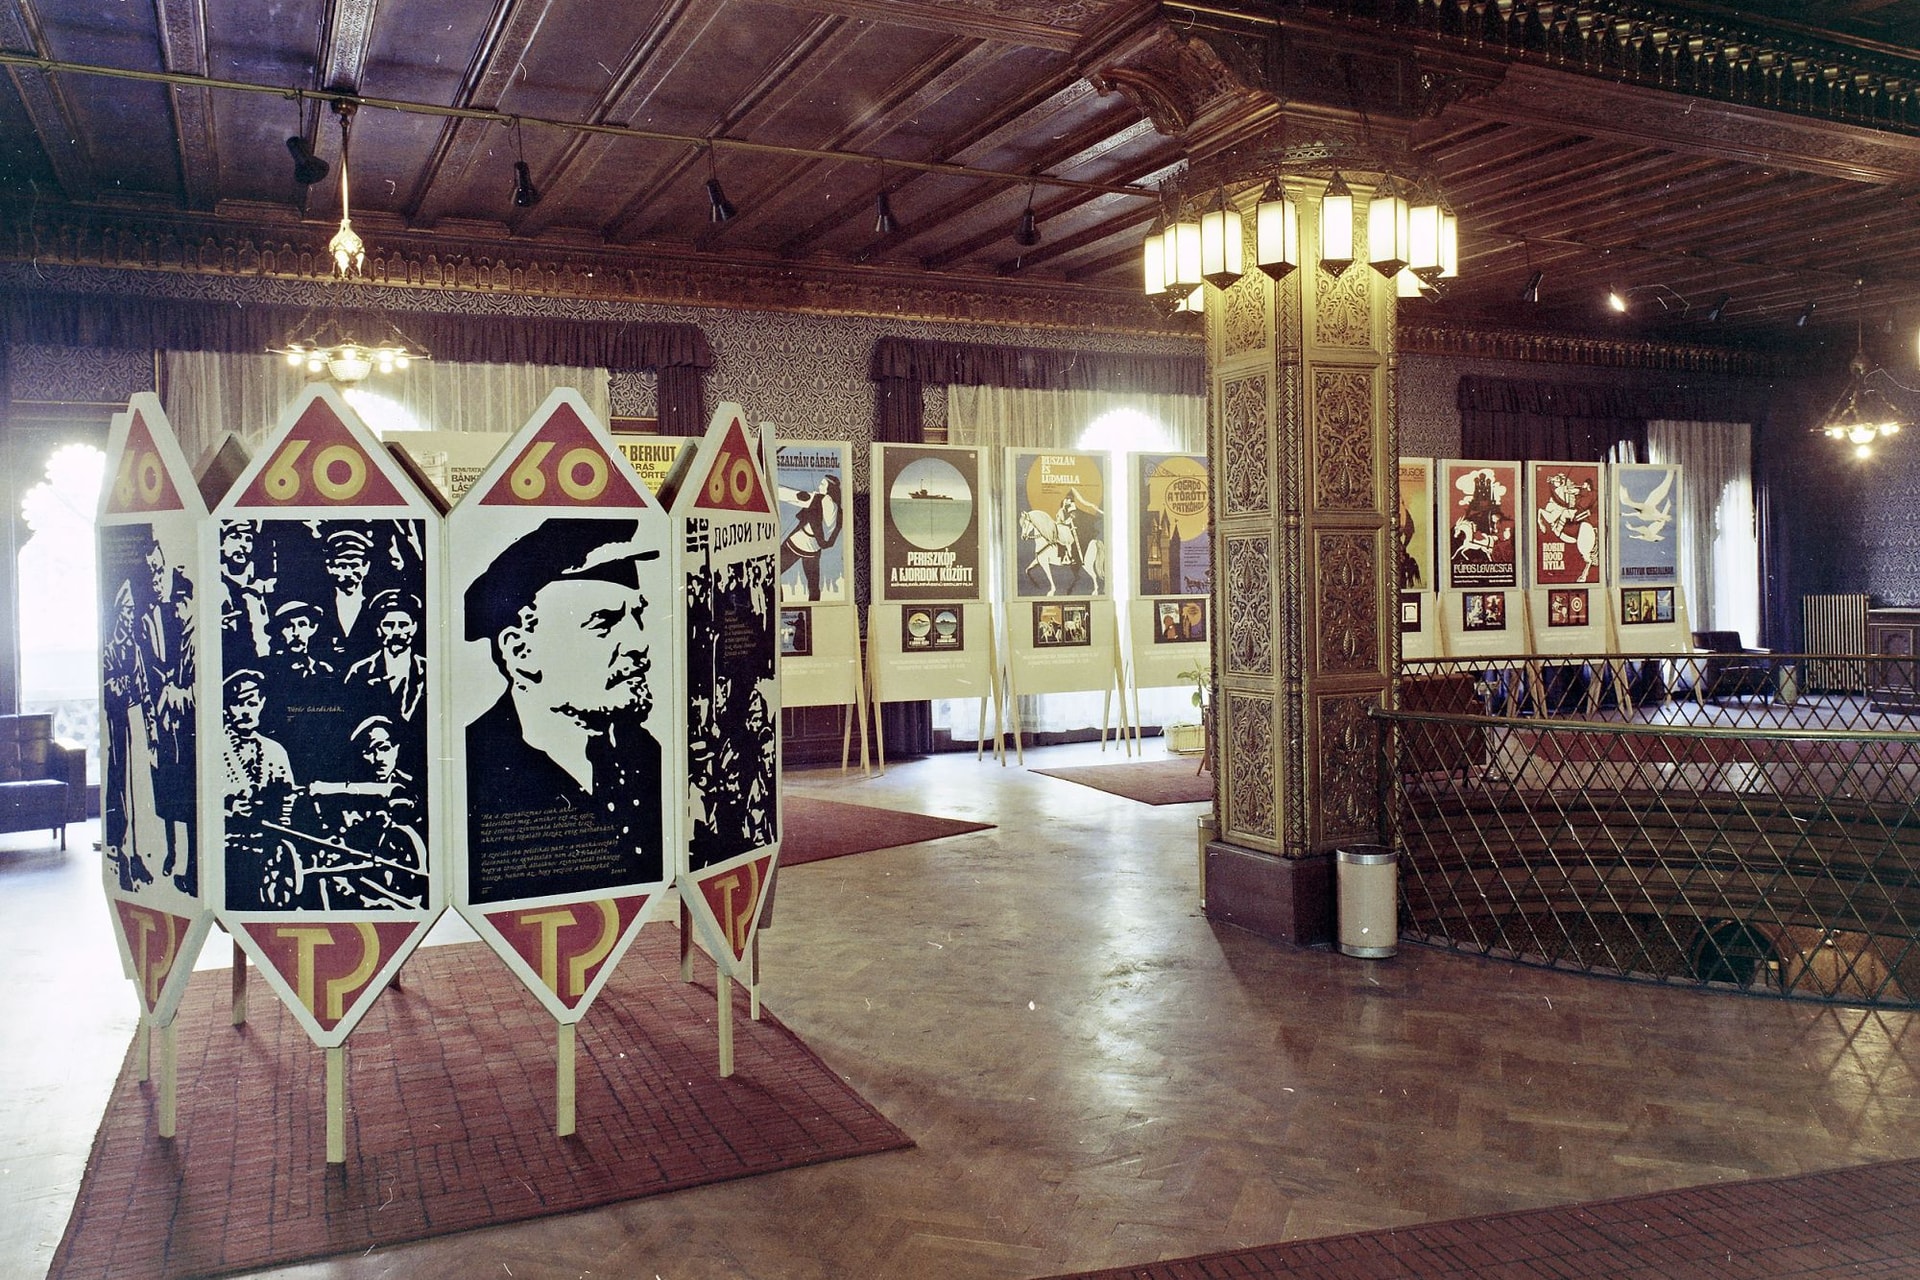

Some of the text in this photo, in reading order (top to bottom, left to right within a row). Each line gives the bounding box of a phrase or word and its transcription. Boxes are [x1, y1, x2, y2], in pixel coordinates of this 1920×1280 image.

[630, 446, 676, 462] BERKUT
[810, 452, 840, 468] CÁRRÓL
[264, 440, 367, 501] 60
[510, 441, 609, 501] 60
[709, 451, 755, 506] 60
[117, 450, 163, 508] 60
[1041, 474, 1080, 484] LUDMILLA
[1173, 480, 1202, 491] FOGADÓ
[1167, 490, 1206, 502] A TÖRÖTT
[907, 548, 956, 566] PERISZKÓP
[1542, 552, 1564, 561] HOOD
[891, 565, 973, 582] A FJORDOK KÖZÖTT
